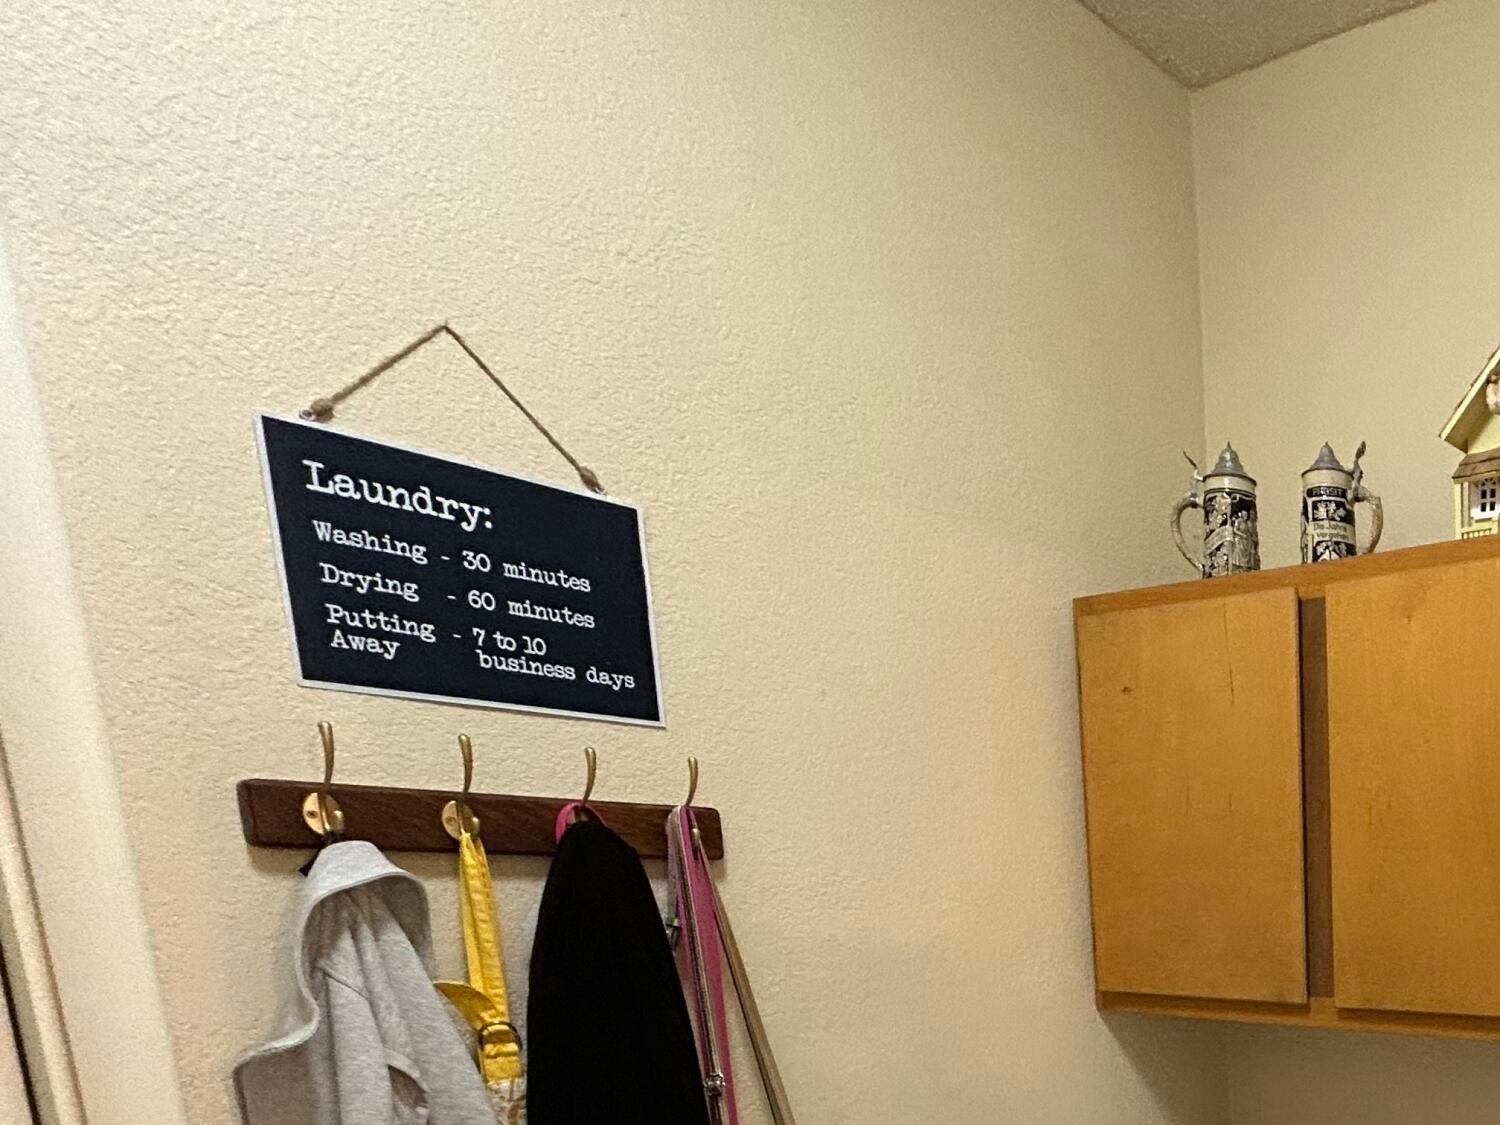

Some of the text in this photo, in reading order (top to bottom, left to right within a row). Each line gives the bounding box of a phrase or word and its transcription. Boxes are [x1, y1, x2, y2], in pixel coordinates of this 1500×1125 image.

[302, 459, 494, 532] Laundry:
[312, 519, 429, 566] Washing
[461, 549, 492, 573] 30
[502, 560, 592, 592] minutes
[319, 562, 420, 602] Drying
[468, 590, 496, 611] 60
[507, 599, 596, 628] minutes
[325, 603, 436, 642] Putting
[472, 627, 486, 647] 7
[493, 631, 517, 651] to
[522, 636, 547, 656] 10
[330, 629, 401, 660] Away
[475, 650, 636, 691] business days
